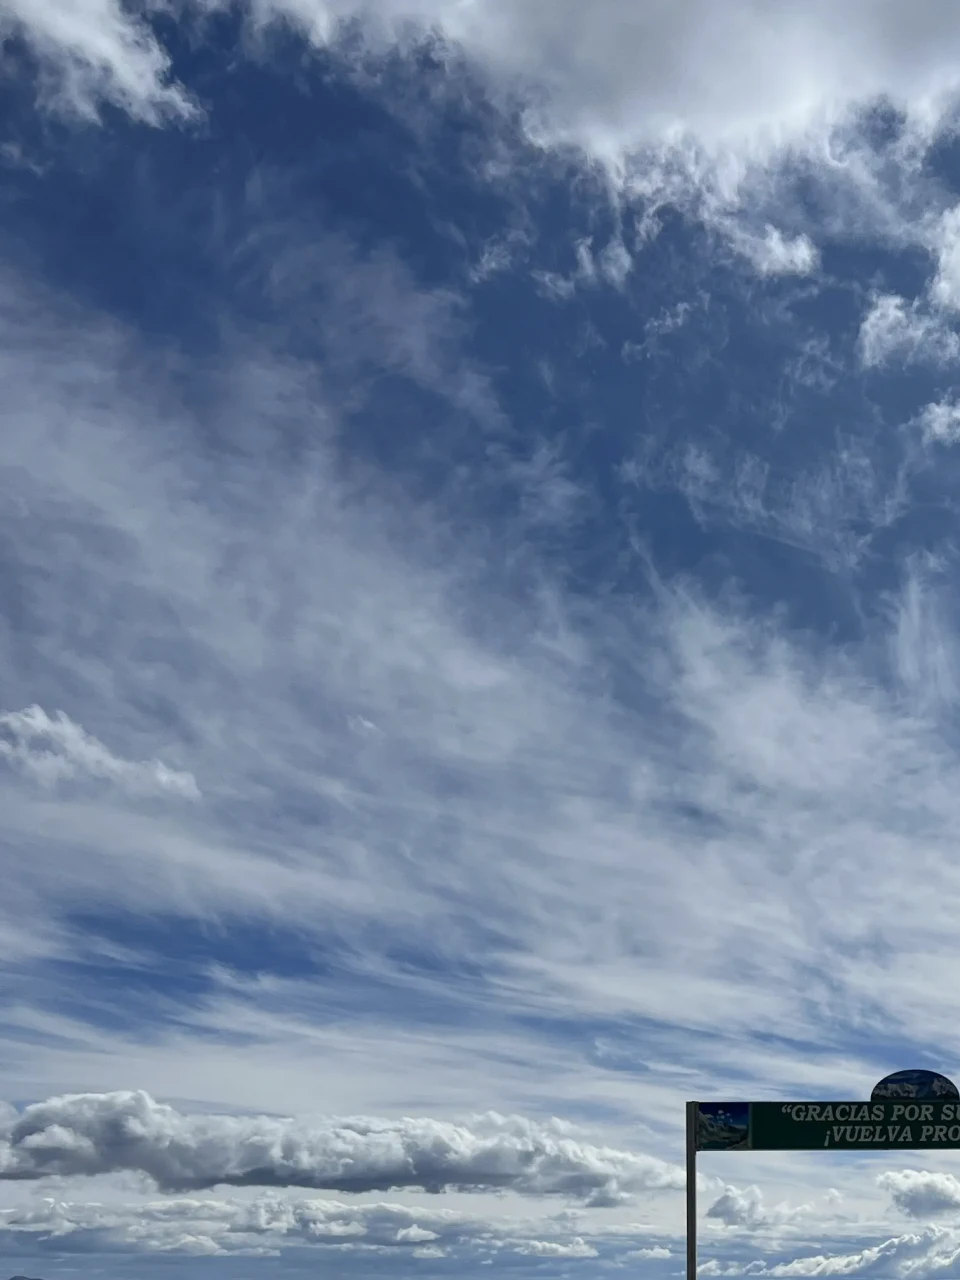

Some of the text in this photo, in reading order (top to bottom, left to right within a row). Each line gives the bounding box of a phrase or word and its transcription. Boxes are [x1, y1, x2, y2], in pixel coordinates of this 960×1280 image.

[781, 1104, 885, 1121] “GRACIAS
[891, 1104, 934, 1121] POR
[823, 1125, 913, 1147] ¡VUELVA
